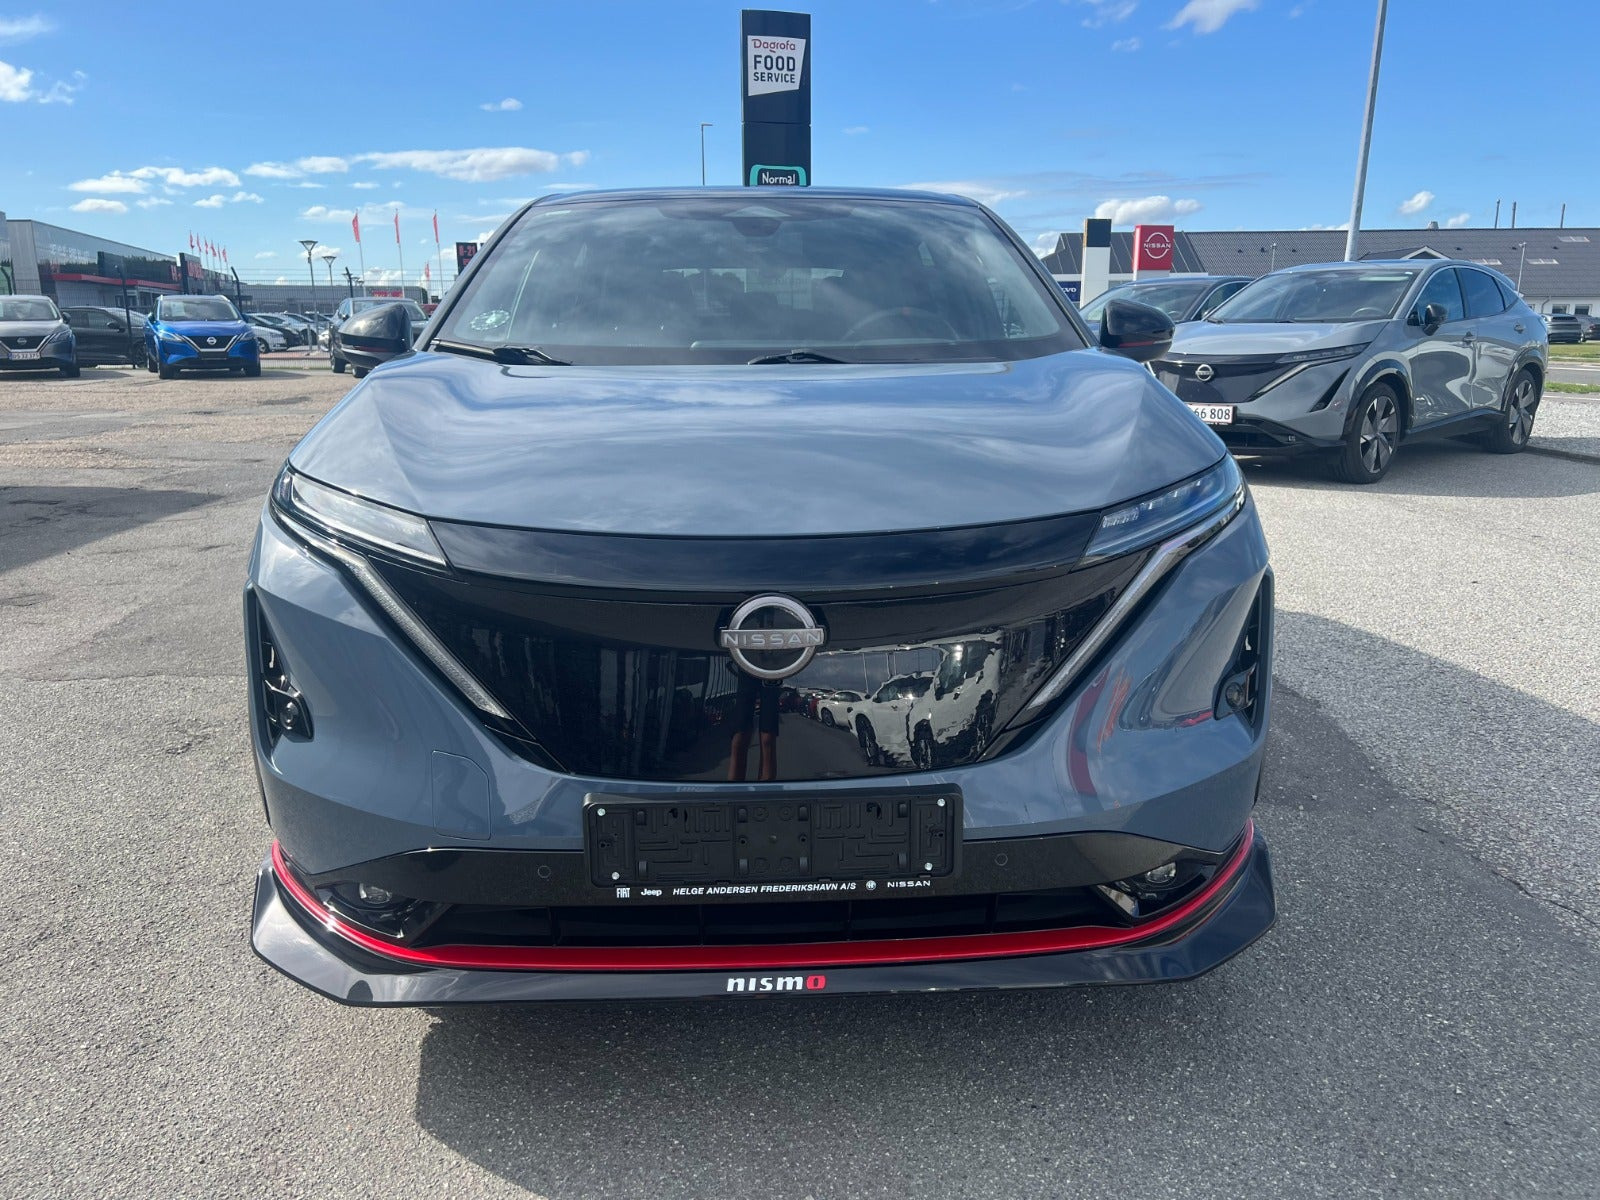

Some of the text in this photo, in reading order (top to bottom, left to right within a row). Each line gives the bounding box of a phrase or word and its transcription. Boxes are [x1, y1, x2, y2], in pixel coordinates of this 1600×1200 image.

[752, 39, 796, 53] Dagrofa
[753, 54, 796, 72] FOOD
[753, 72, 796, 83] SERVICE
[762, 171, 796, 185] Normal
[1209, 408, 1231, 420] 808
[723, 632, 821, 646] NISSAN
[616, 888, 630, 898] FIAT
[641, 889, 662, 897] Jeep
[706, 886, 758, 894] ANDERSEN
[760, 883, 838, 892] FREDERIKSHAVN
[840, 882, 857, 890] A/S
[887, 880, 931, 888] NISSAN
[726, 975, 826, 992] nismo
